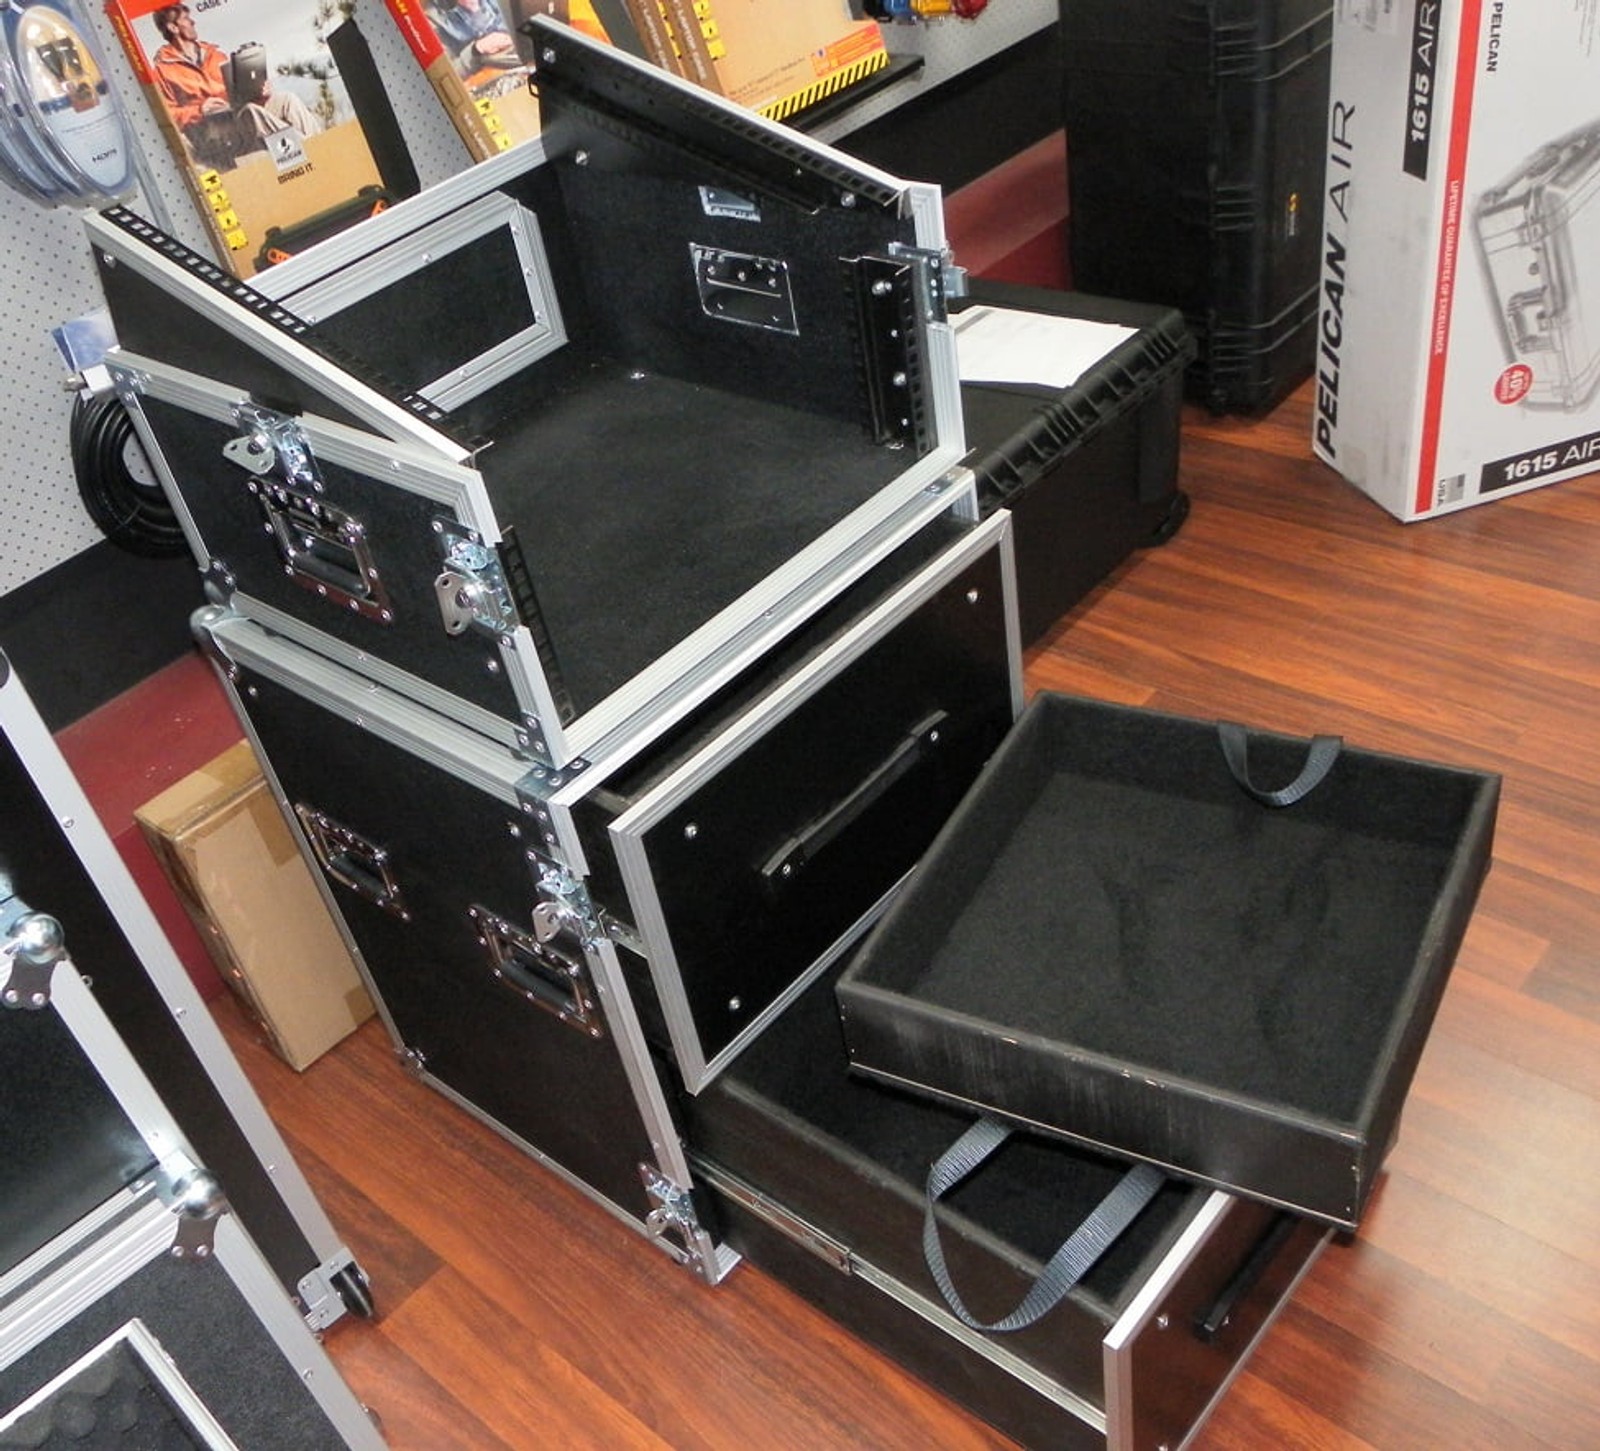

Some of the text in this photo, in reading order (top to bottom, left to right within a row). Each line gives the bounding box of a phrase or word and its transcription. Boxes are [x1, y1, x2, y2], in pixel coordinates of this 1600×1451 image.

[1411, 1, 1438, 143] 1615 AIR
[1486, 1, 1504, 73] PELICAN
[1316, 101, 1357, 460] PELICAN AIR
[1504, 451, 1558, 481] 1615
